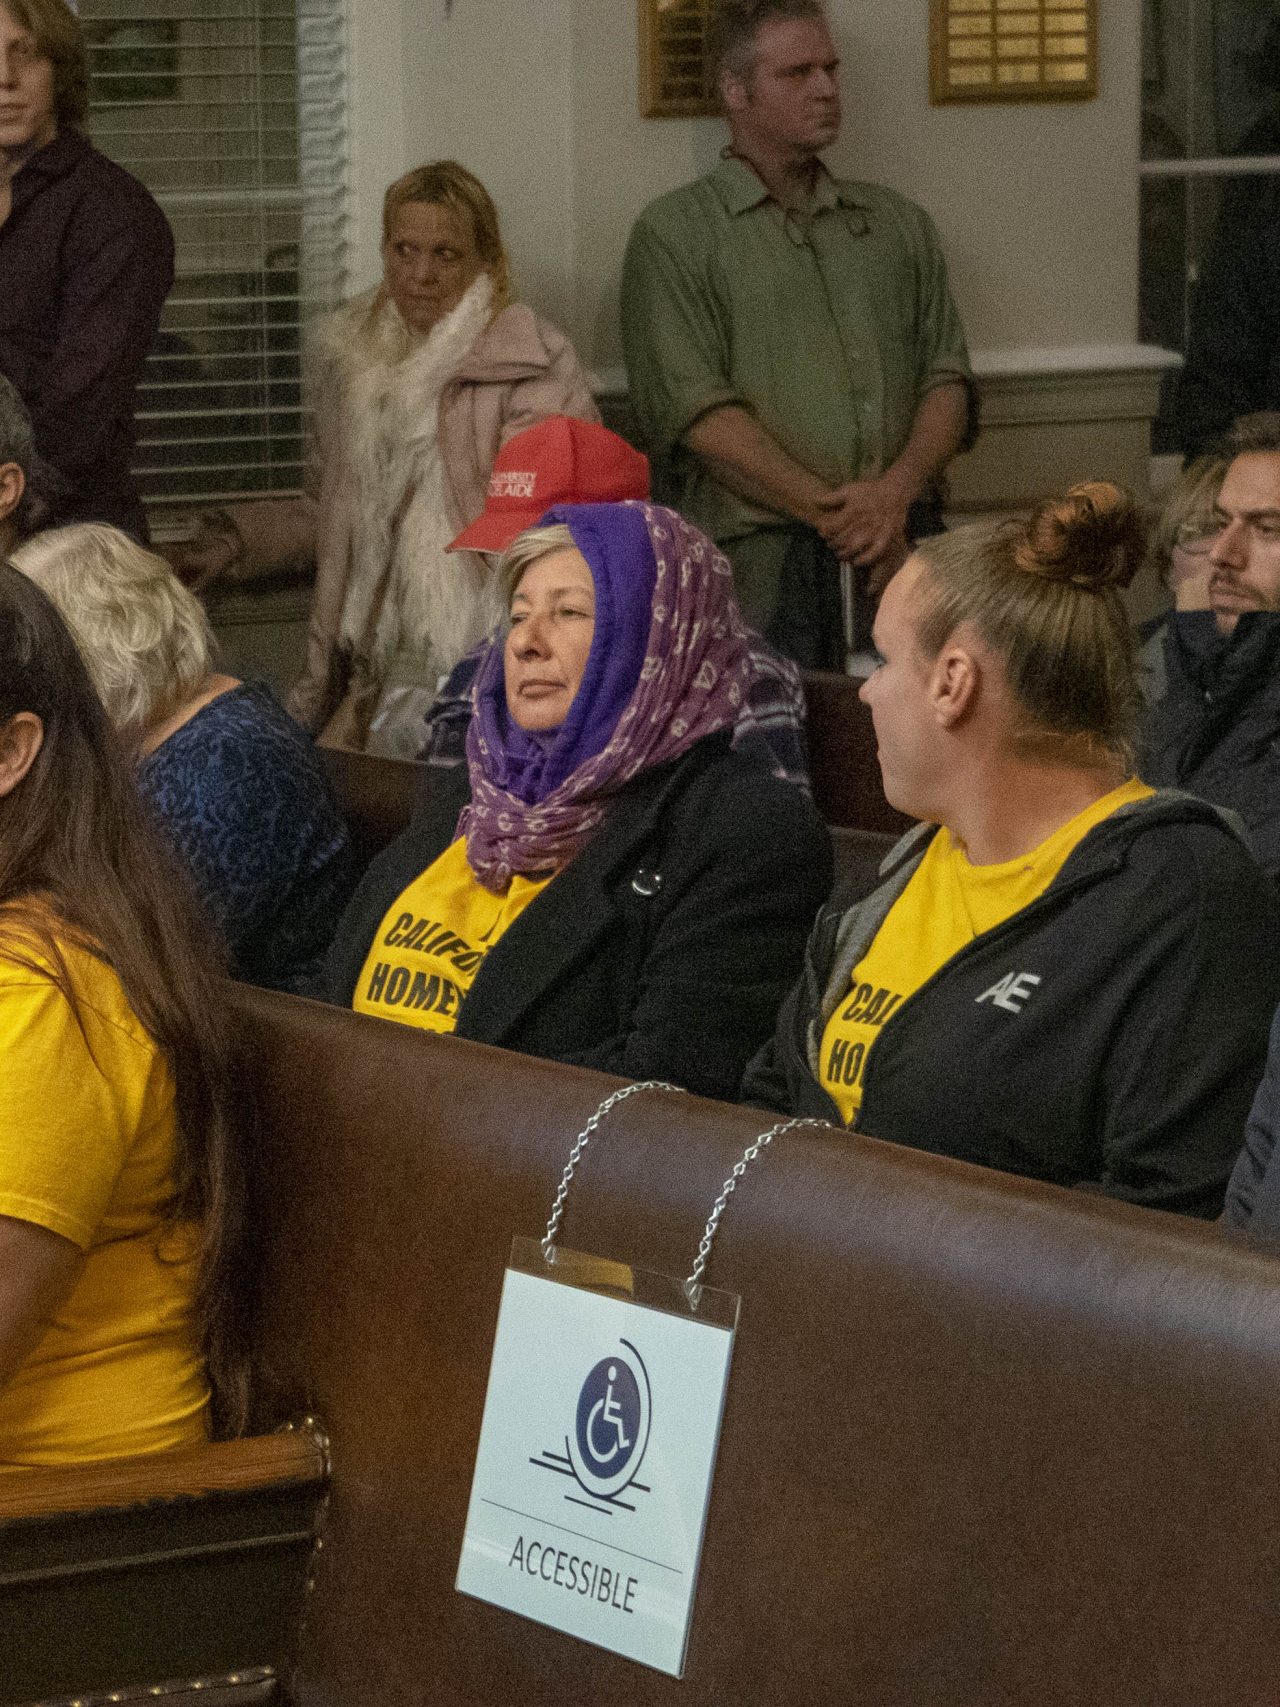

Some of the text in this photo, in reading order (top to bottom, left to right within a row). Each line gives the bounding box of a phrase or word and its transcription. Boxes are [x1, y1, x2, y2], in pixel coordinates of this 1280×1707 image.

[384, 912, 483, 976] CALIFO
[366, 962, 456, 1015] HOME
[508, 1535, 639, 1614] ACCESSIBLE
